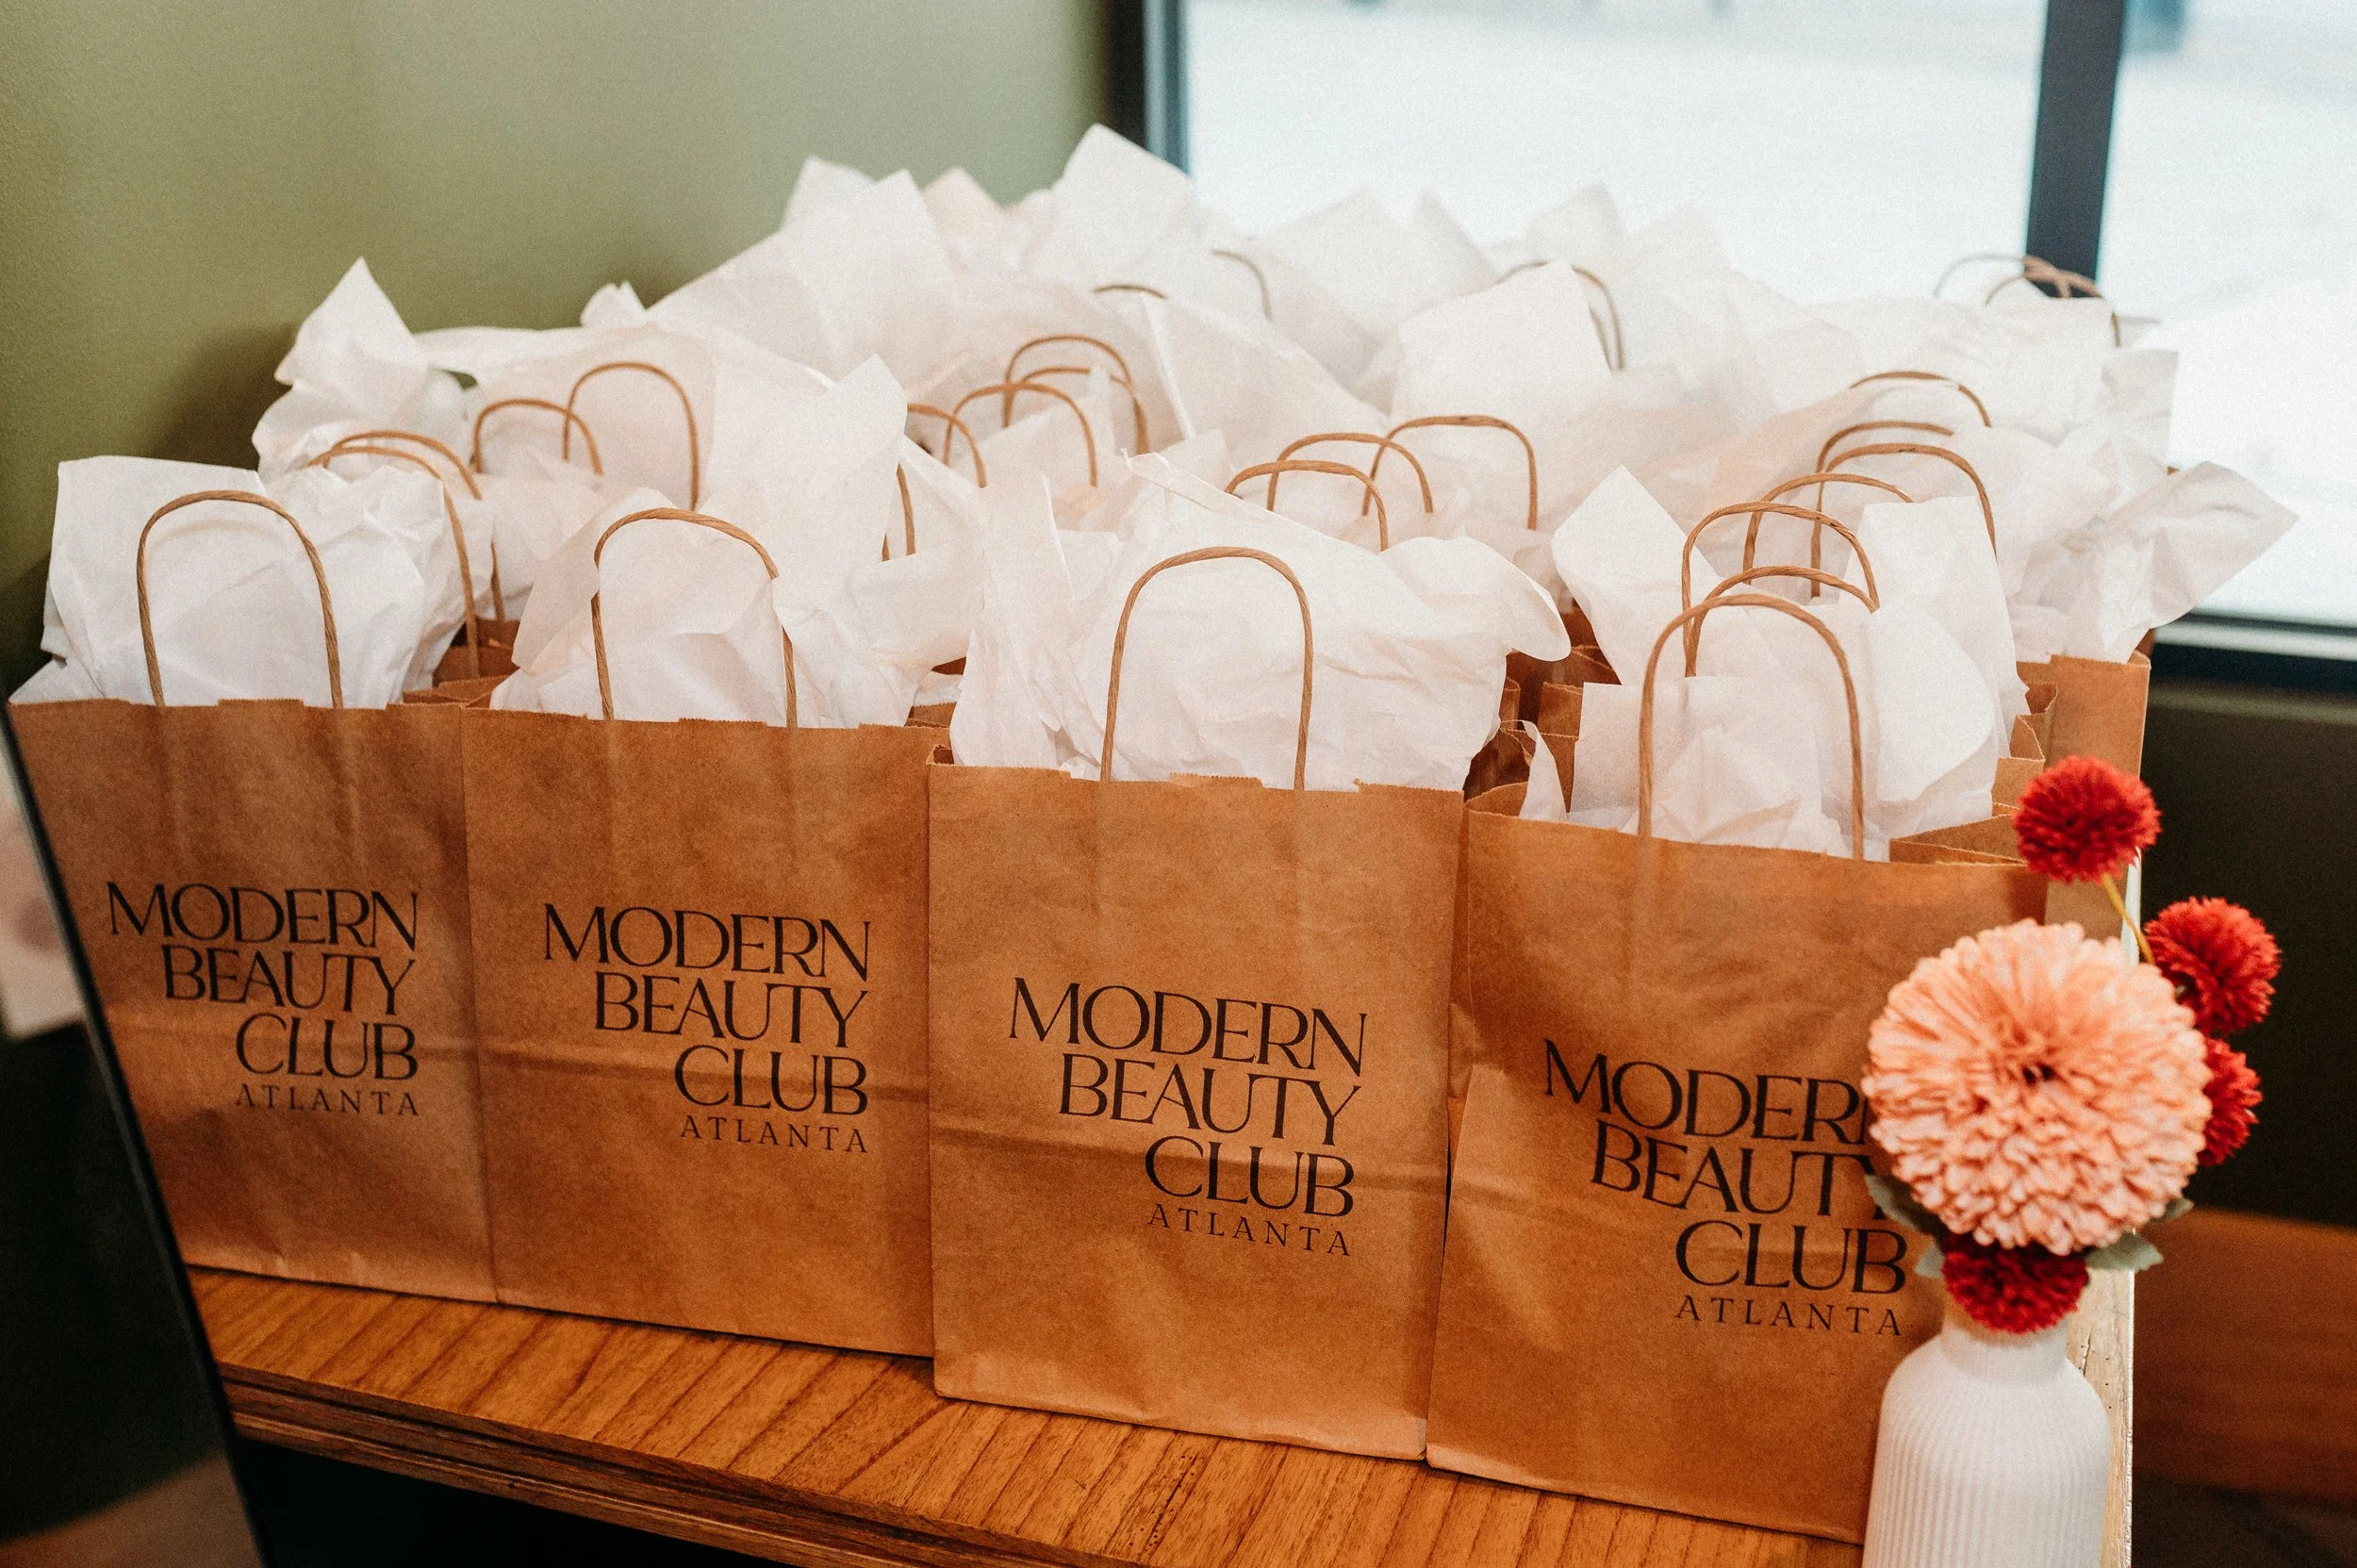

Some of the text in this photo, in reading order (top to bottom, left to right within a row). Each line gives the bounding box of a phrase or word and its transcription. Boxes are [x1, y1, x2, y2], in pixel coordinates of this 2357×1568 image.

[107, 882, 418, 951] MODERN
[544, 903, 871, 982] MODERN
[162, 944, 416, 1015] BEAUTY
[595, 971, 868, 1048] BEAUTY
[236, 1012, 418, 1081] CLUB
[1009, 977, 1367, 1077] MODERN
[236, 1083, 419, 1116] ATLANTA
[674, 1044, 868, 1115] CLUB
[1059, 1053, 1361, 1146] BEAUTY
[1544, 1038, 1870, 1146] MODER
[680, 1114, 867, 1153] ATLANTA
[1145, 1136, 1354, 1217] CLUB
[1147, 1203, 1350, 1256] ATLANTA
[1675, 1219, 1908, 1295] CLUB
[1676, 1295, 1902, 1336] ATLANTA
